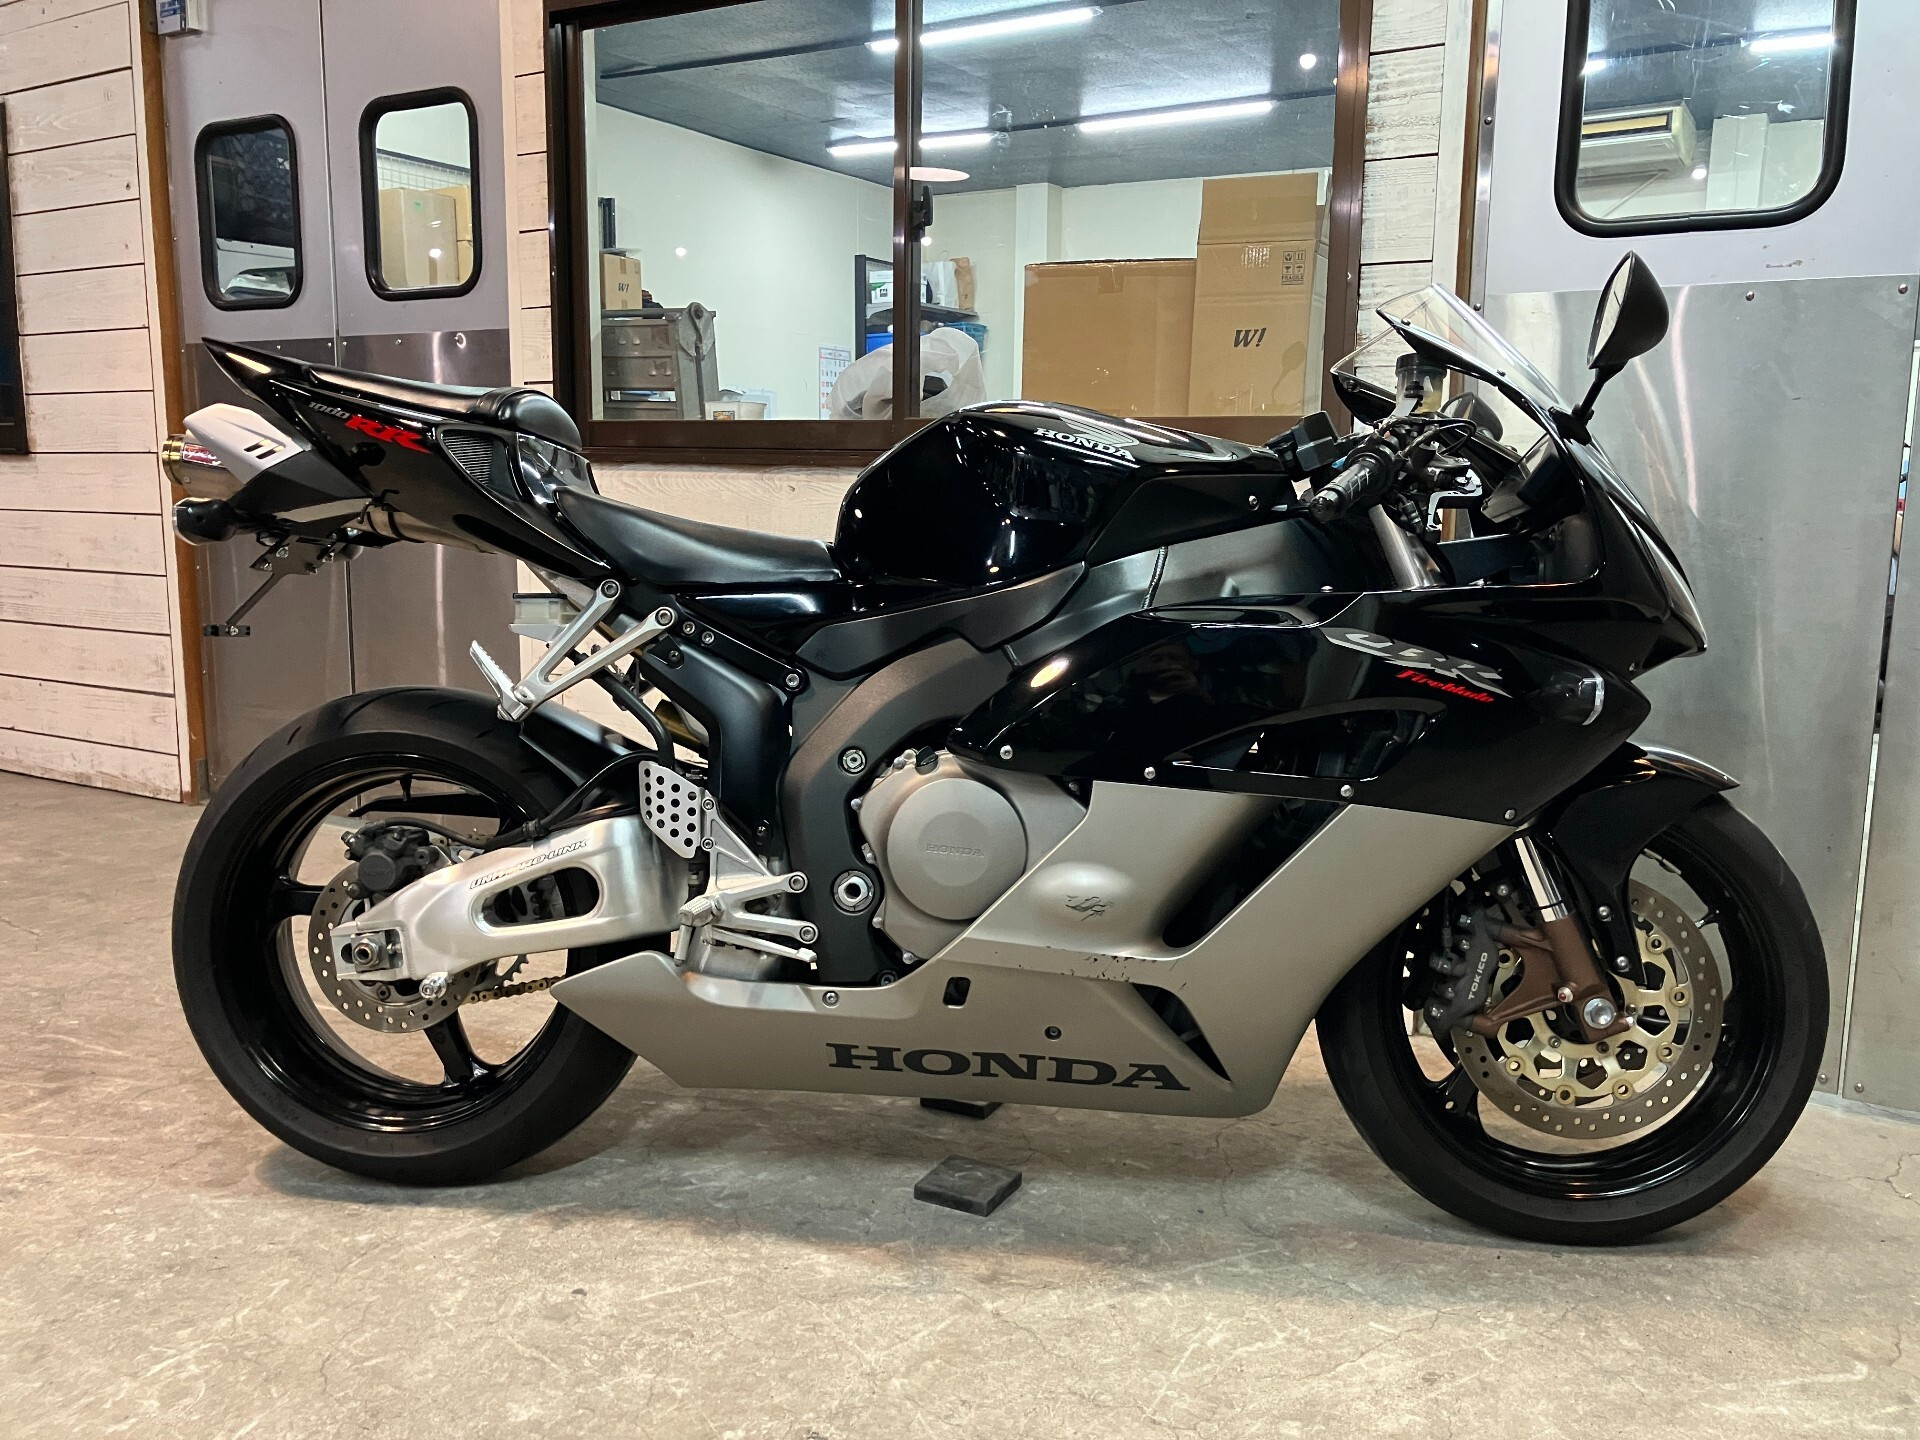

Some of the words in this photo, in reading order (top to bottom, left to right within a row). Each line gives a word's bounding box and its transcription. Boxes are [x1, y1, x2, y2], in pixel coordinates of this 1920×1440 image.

[1233, 326, 1267, 348] W!
[1033, 427, 1136, 462] HONDA
[925, 843, 985, 858] HONDA
[1467, 952, 1488, 1000] TOKICO
[826, 1042, 1192, 1092] HONDA
